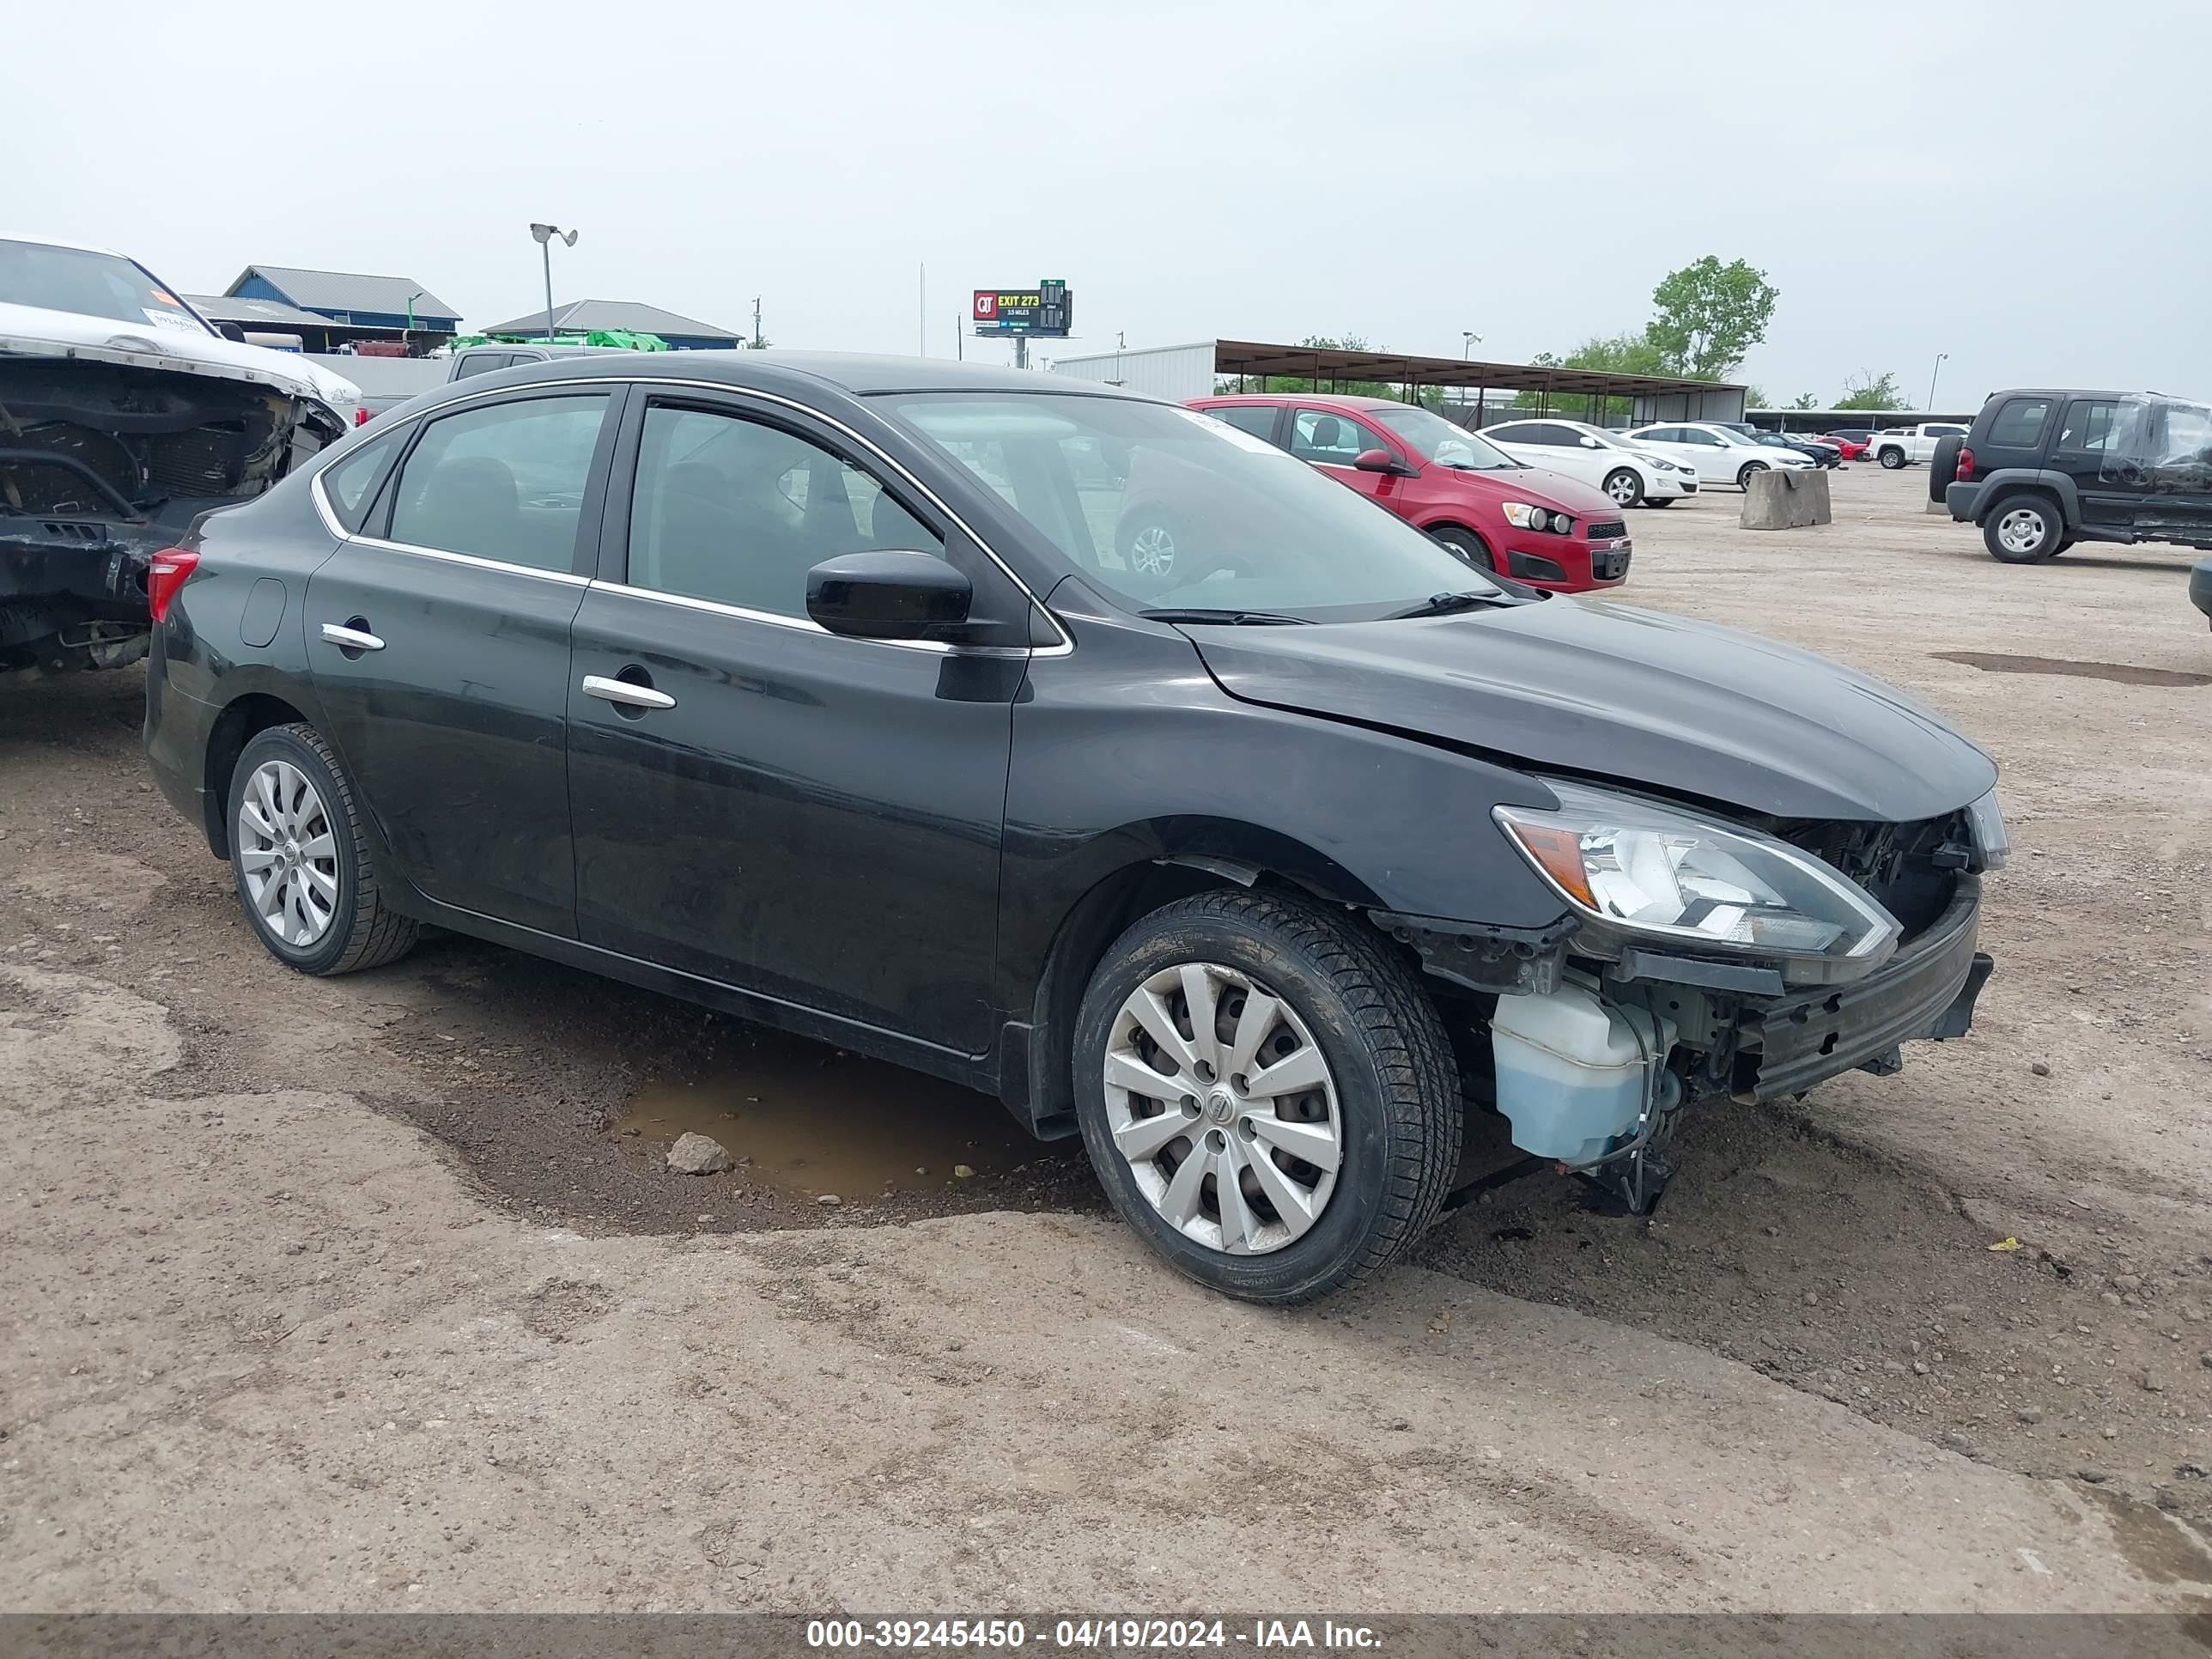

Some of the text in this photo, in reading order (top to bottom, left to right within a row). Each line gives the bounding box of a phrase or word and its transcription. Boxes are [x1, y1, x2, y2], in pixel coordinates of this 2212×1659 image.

[977, 296, 994, 314] QT
[998, 295, 1040, 306] EXIT 273
